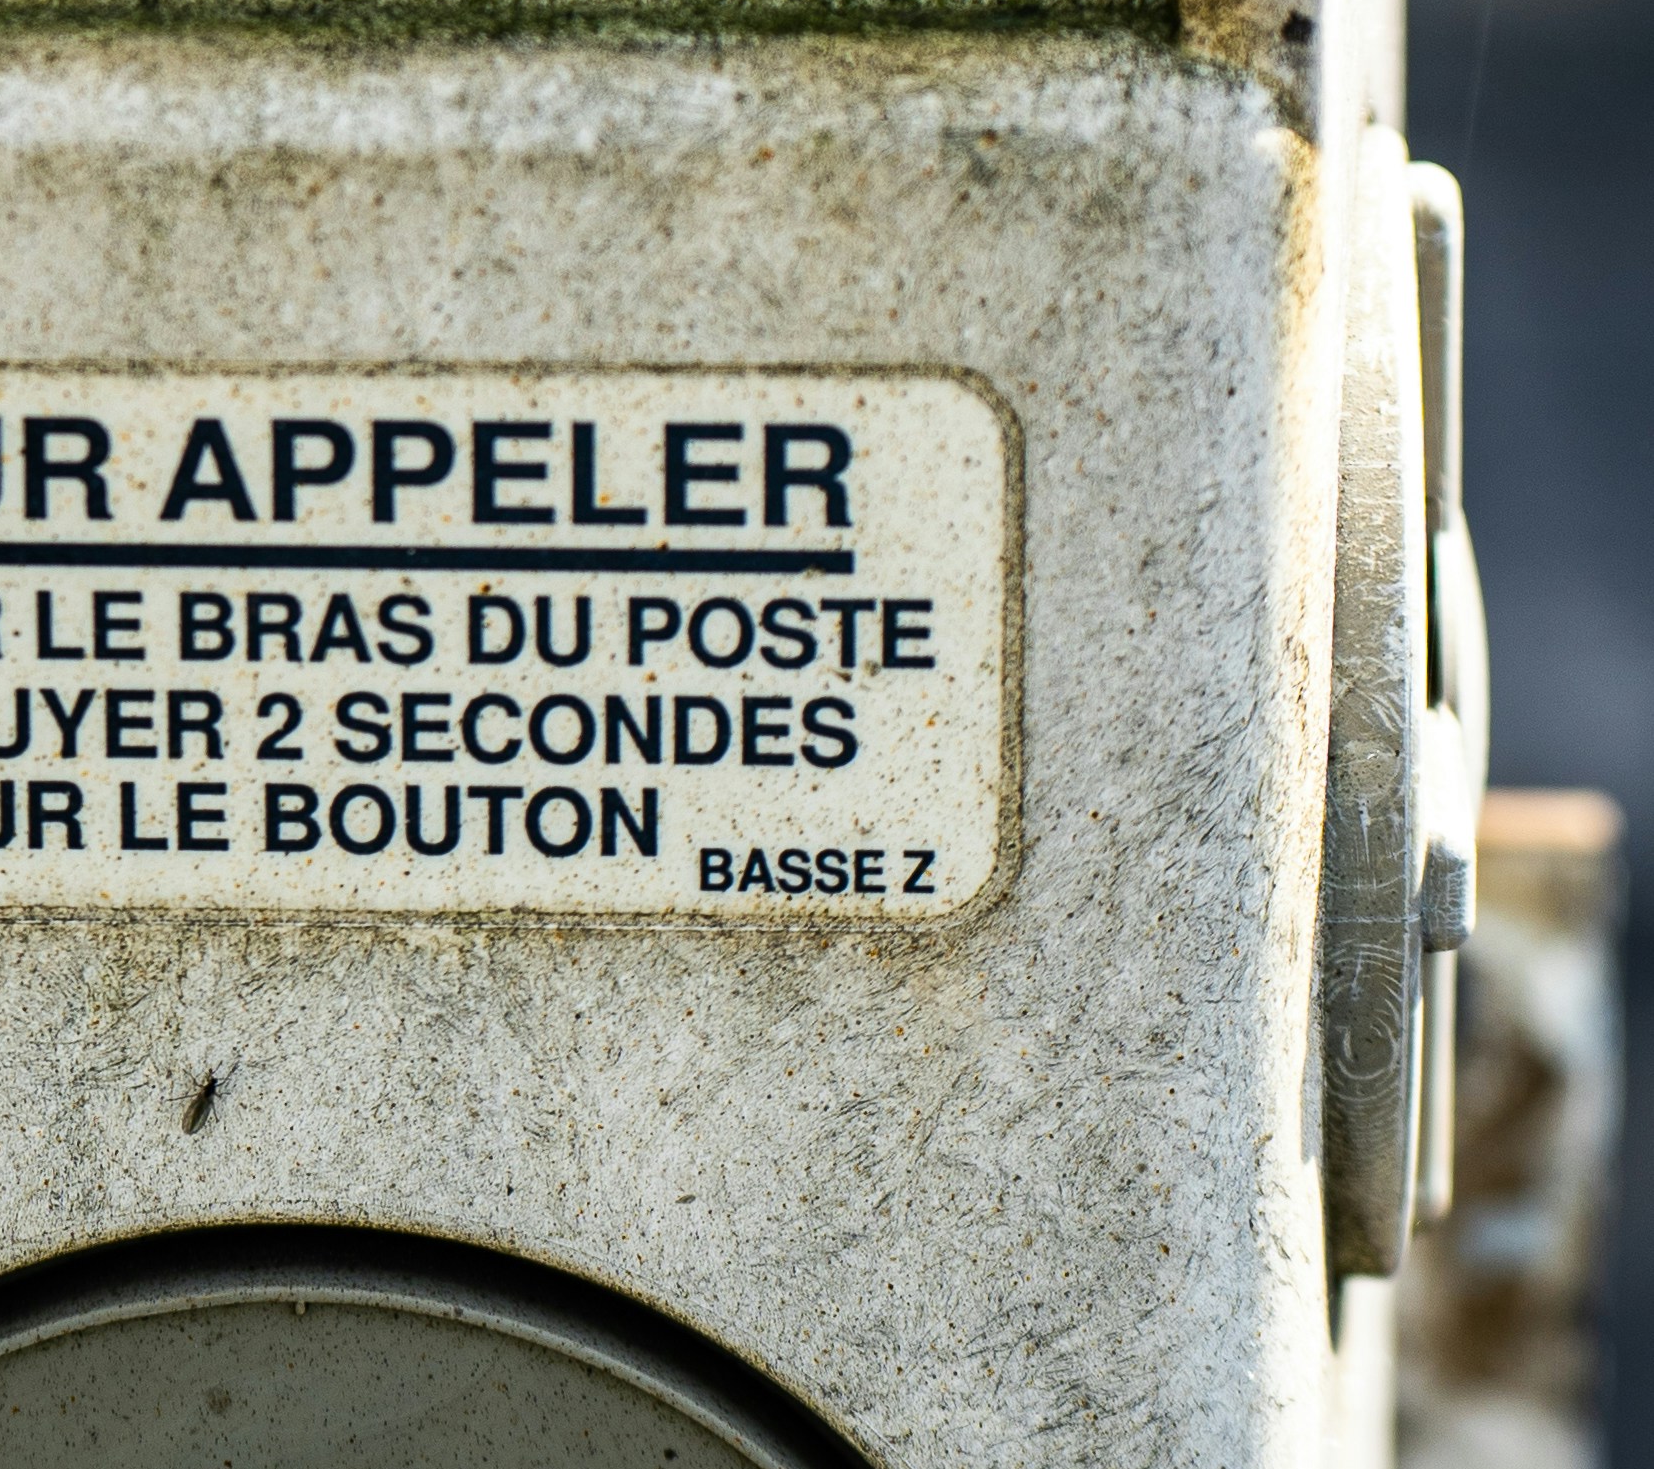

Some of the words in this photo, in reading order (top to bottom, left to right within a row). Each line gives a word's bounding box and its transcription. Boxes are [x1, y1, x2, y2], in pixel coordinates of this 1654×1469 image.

[158, 417, 854, 529] APPELER
[36, 589, 146, 662] LE
[178, 590, 434, 668] BRAS
[467, 593, 592, 668] DU
[627, 595, 937, 670] POSTE
[256, 692, 304, 761] 2
[333, 690, 860, 770] SECONDES
[119, 781, 230, 852] LE
[263, 782, 660, 859] BOUTON
[698, 846, 888, 899] BASSE
[902, 848, 937, 895] Z
